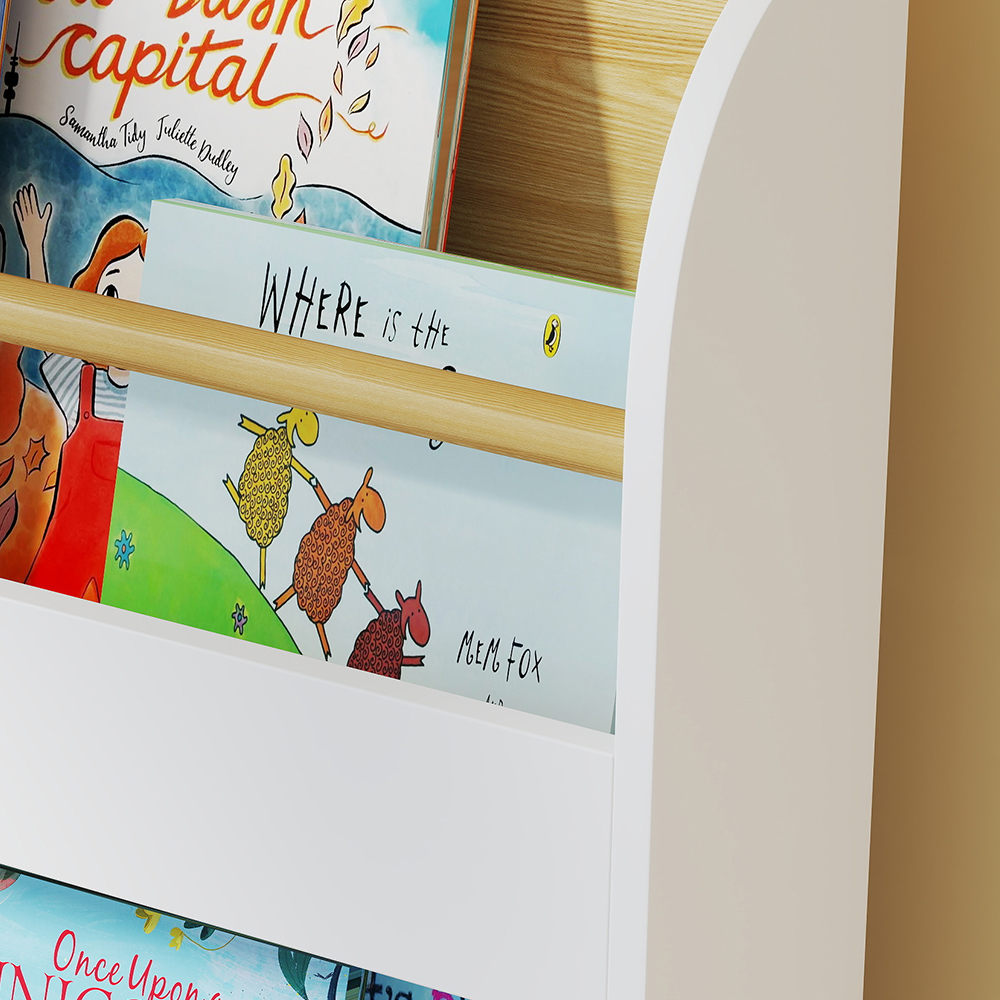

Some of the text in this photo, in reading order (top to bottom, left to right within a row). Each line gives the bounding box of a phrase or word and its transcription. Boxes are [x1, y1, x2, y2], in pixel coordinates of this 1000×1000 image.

[19, 23, 322, 120] capital
[59, 105, 239, 185] Samantha Tidy Juliette Dudley
[259, 261, 369, 338] WHERE
[456, 630, 543, 683] MEM FOX
[53, 929, 124, 986] Once
